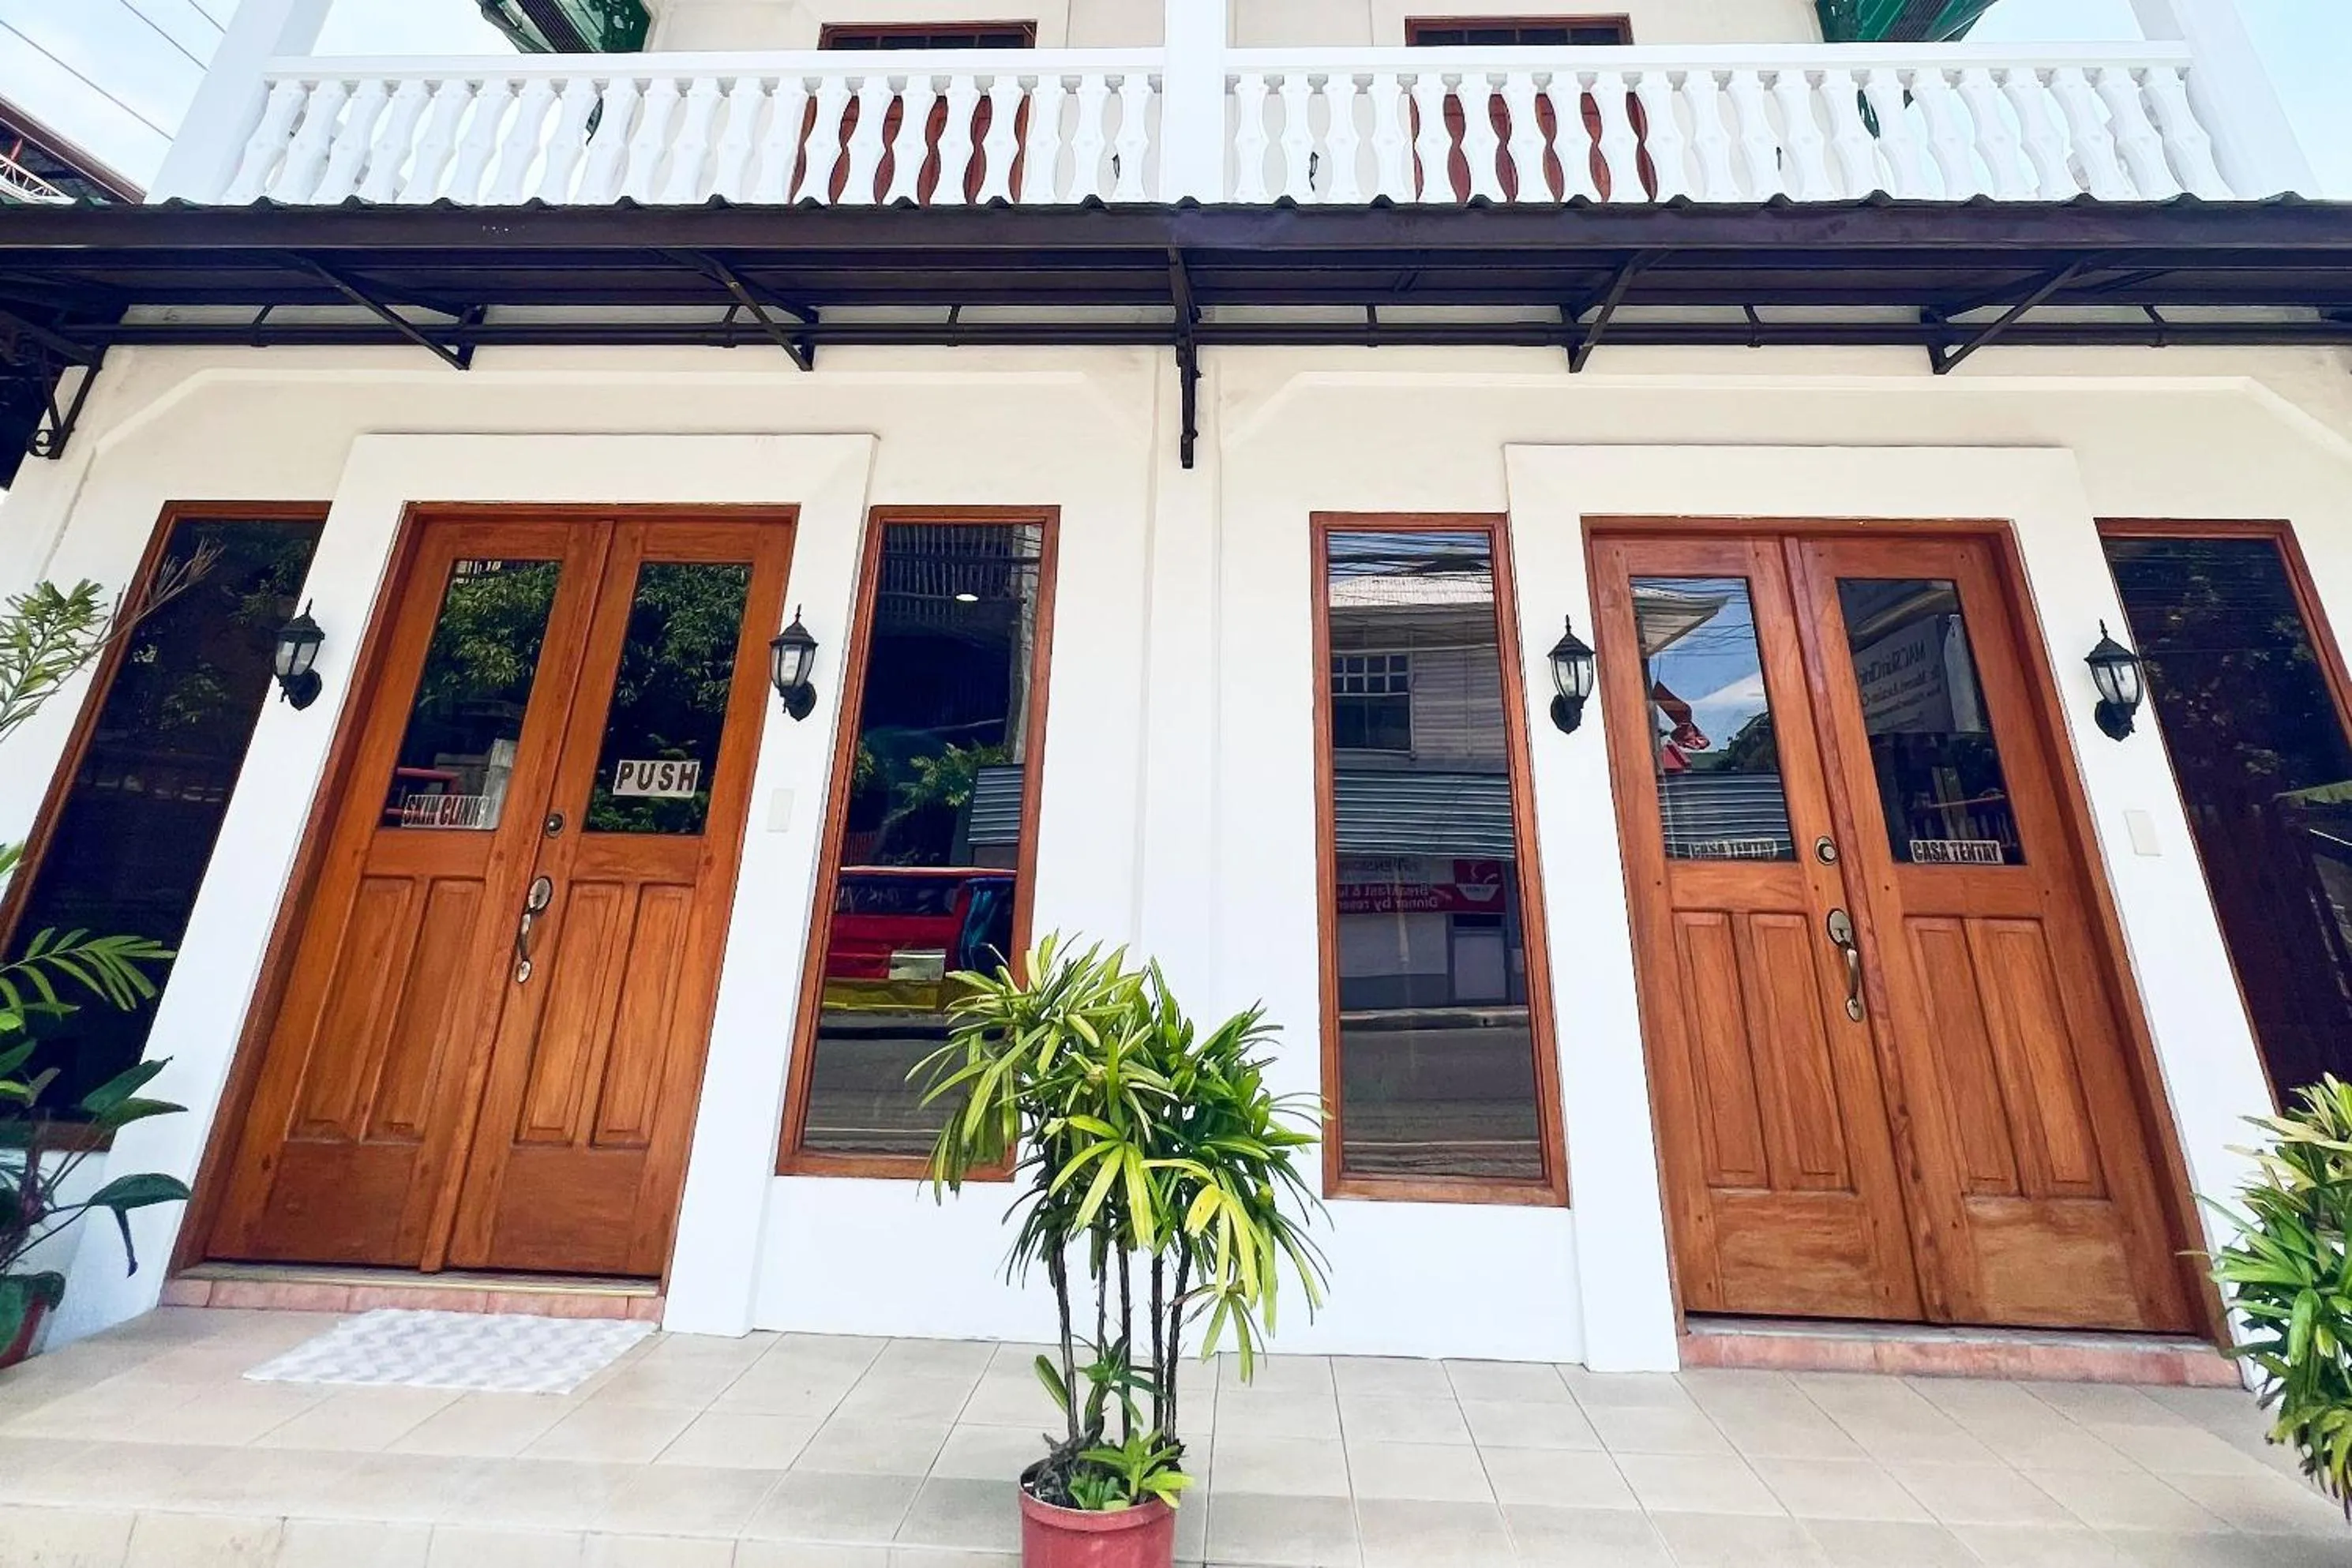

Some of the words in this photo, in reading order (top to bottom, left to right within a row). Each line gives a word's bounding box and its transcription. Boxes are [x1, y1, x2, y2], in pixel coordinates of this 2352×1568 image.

[617, 762, 698, 791] PUSH
[1912, 842, 1951, 861] CASA
[1949, 842, 1999, 862] TENTAY
